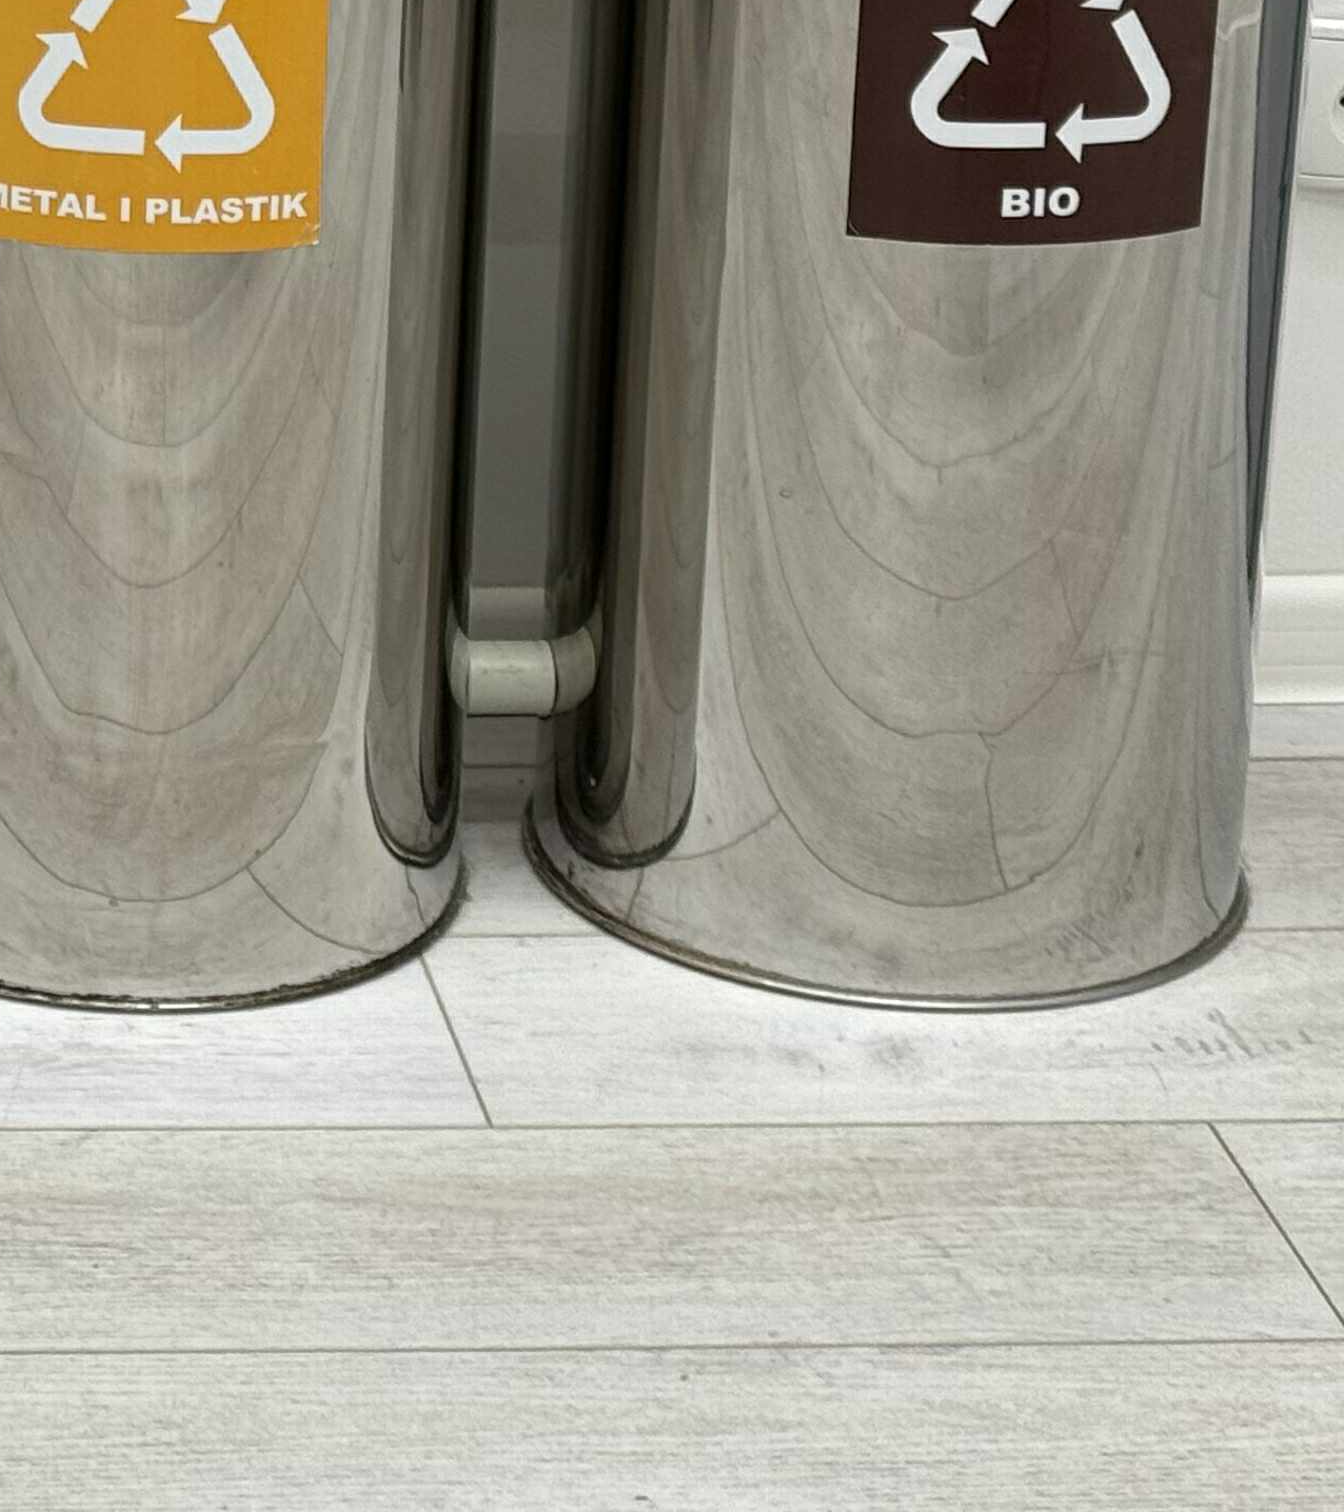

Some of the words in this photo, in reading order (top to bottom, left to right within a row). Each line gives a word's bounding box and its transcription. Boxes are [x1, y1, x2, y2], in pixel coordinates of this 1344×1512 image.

[119, 196, 132, 222] I
[144, 191, 308, 225] PLASTIK
[1000, 186, 1081, 218] BIO
